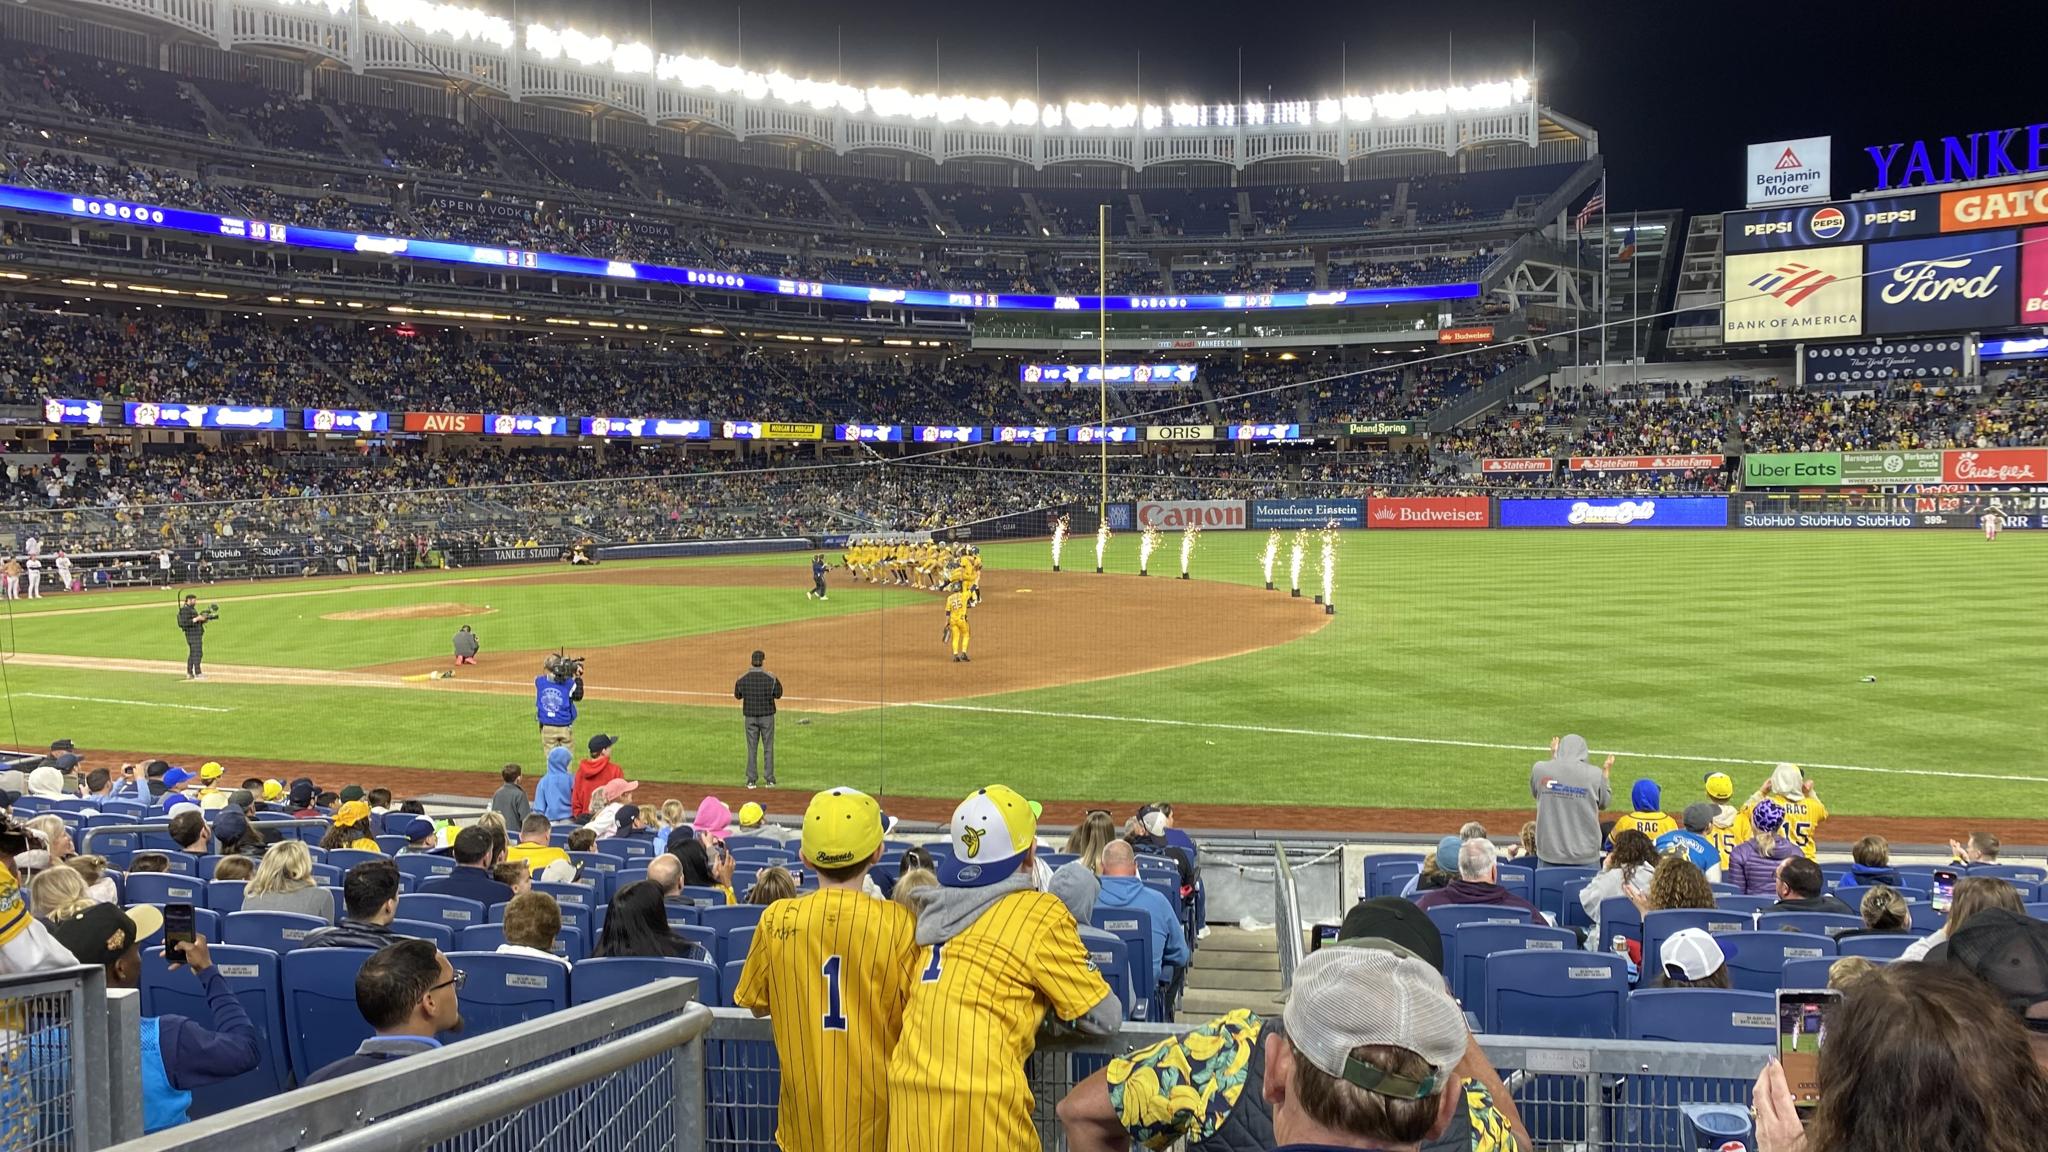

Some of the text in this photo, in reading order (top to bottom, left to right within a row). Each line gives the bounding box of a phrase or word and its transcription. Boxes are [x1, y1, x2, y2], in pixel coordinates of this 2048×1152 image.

[1756, 168, 1821, 186] Benjamin
[1764, 182, 1809, 197] Moore
[431, 198, 522, 217] ASPEN VODK
[1813, 217, 1843, 228] PEPSI
[1865, 209, 1917, 226] PEPSI
[251, 223, 266, 237] 10
[272, 226, 286, 241] 14
[633, 223, 670, 236] VODKA
[1745, 221, 1793, 237] PEPSI
[508, 252, 518, 265] 2
[1881, 258, 2002, 304] Ford
[1728, 314, 1858, 331] BANK OF AMERICA
[1454, 331, 1491, 340] Budweiser
[1867, 357, 1884, 368] York
[1886, 356, 1916, 368] Yankees
[424, 416, 466, 431] AVIS
[771, 424, 790, 432] MORGAN
[795, 424, 813, 432] MORGAN
[1350, 423, 1406, 435] Poland Spring
[1160, 426, 1200, 440] ORIS
[1844, 454, 1882, 463] Morningside
[1750, 463, 1836, 477] Uber Eats
[1955, 458, 2034, 479] Chick-fil-A
[1138, 504, 1243, 527] Canon
[1256, 504, 1358, 515] Montefiore Einstein
[1400, 508, 1483, 521] Budweiser
[1744, 516, 1795, 527] StubHub
[1800, 516, 1852, 527] StubHub
[1857, 516, 1911, 527] StubHub
[211, 550, 241, 558] tubHub
[495, 550, 526, 560] YANKEE
[1786, 803, 1808, 815] RAC
[1637, 820, 1658, 833] RAC
[1783, 822, 1812, 847] 15
[1713, 832, 1735, 854] 15
[822, 954, 848, 1032] 1
